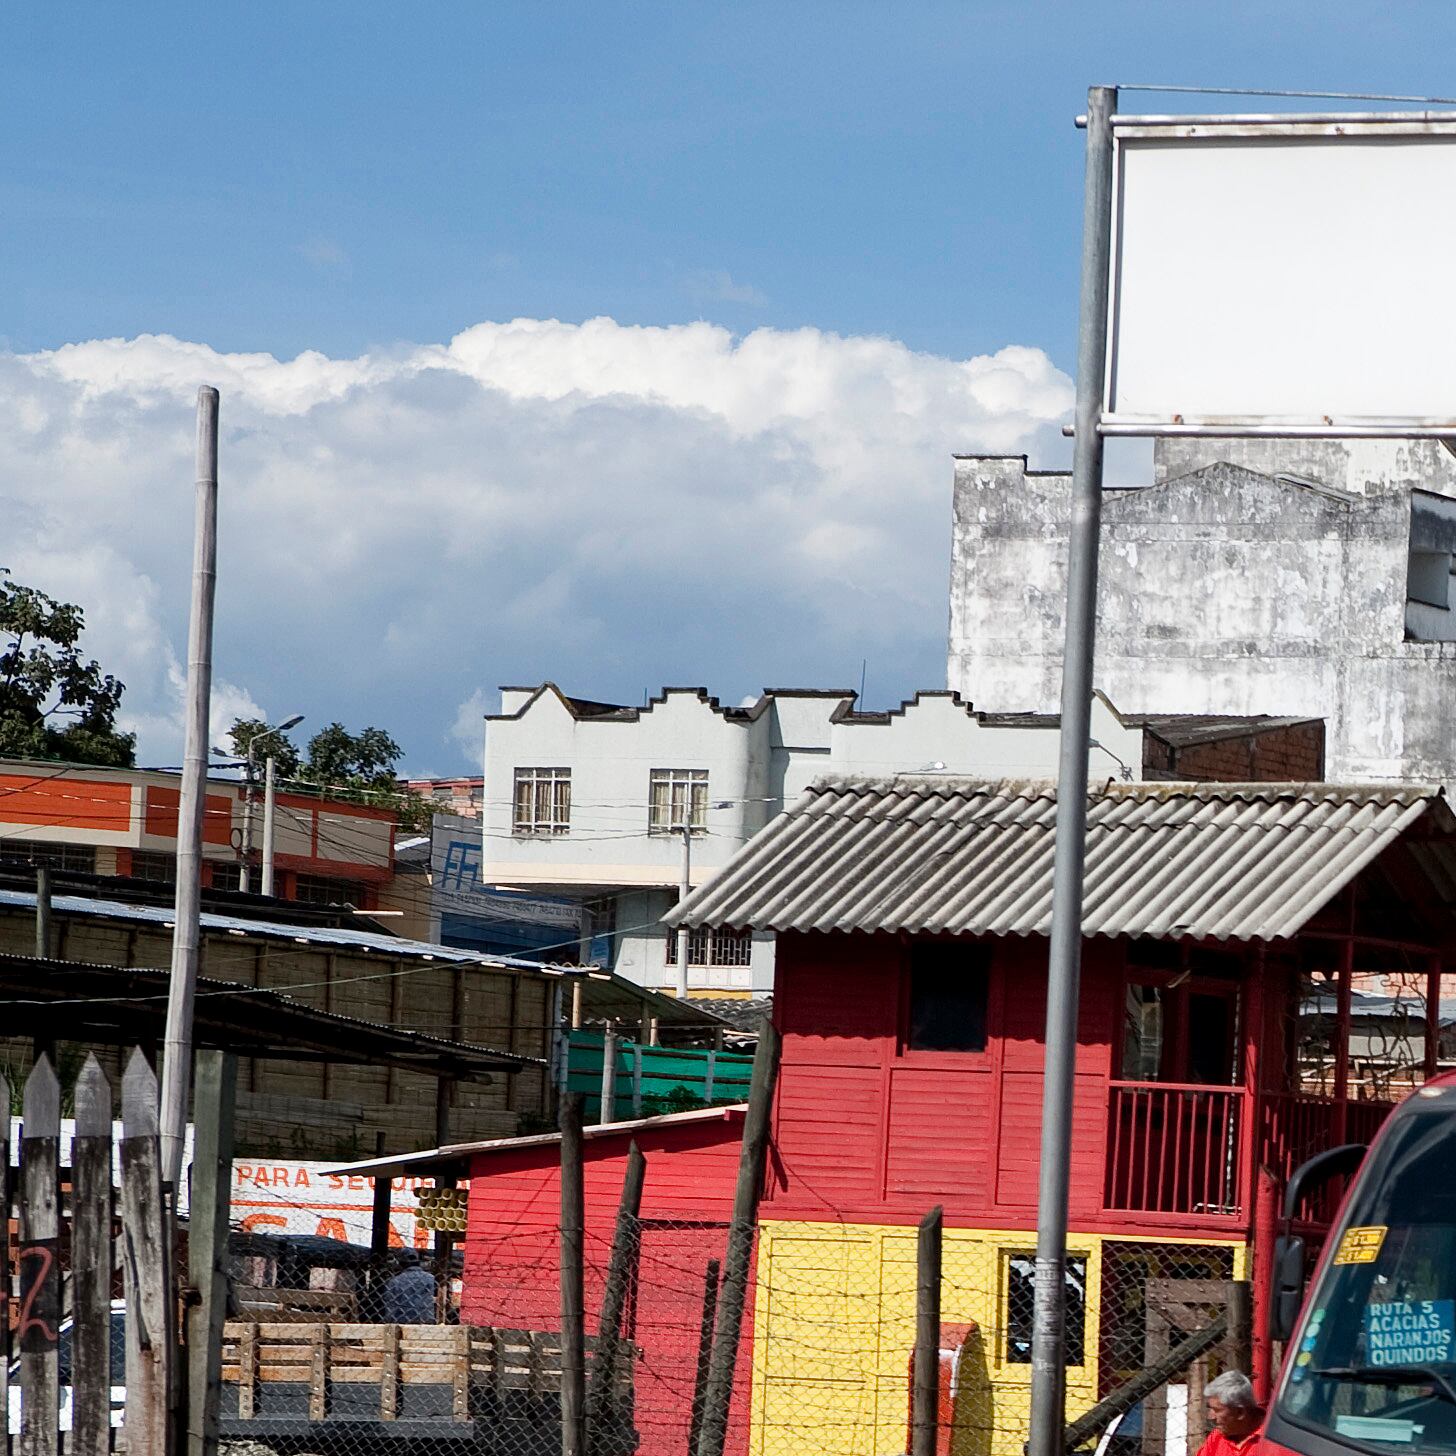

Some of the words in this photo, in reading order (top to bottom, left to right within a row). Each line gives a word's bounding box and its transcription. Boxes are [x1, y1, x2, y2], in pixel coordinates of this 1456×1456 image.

[236, 1165, 310, 1188] PARA
[1370, 1302, 1412, 1317] RUTA
[1369, 1313, 1440, 1333] ACACIAS
[1369, 1329, 1451, 1349] NARANJOS
[1371, 1346, 1448, 1366] QUINDOS
